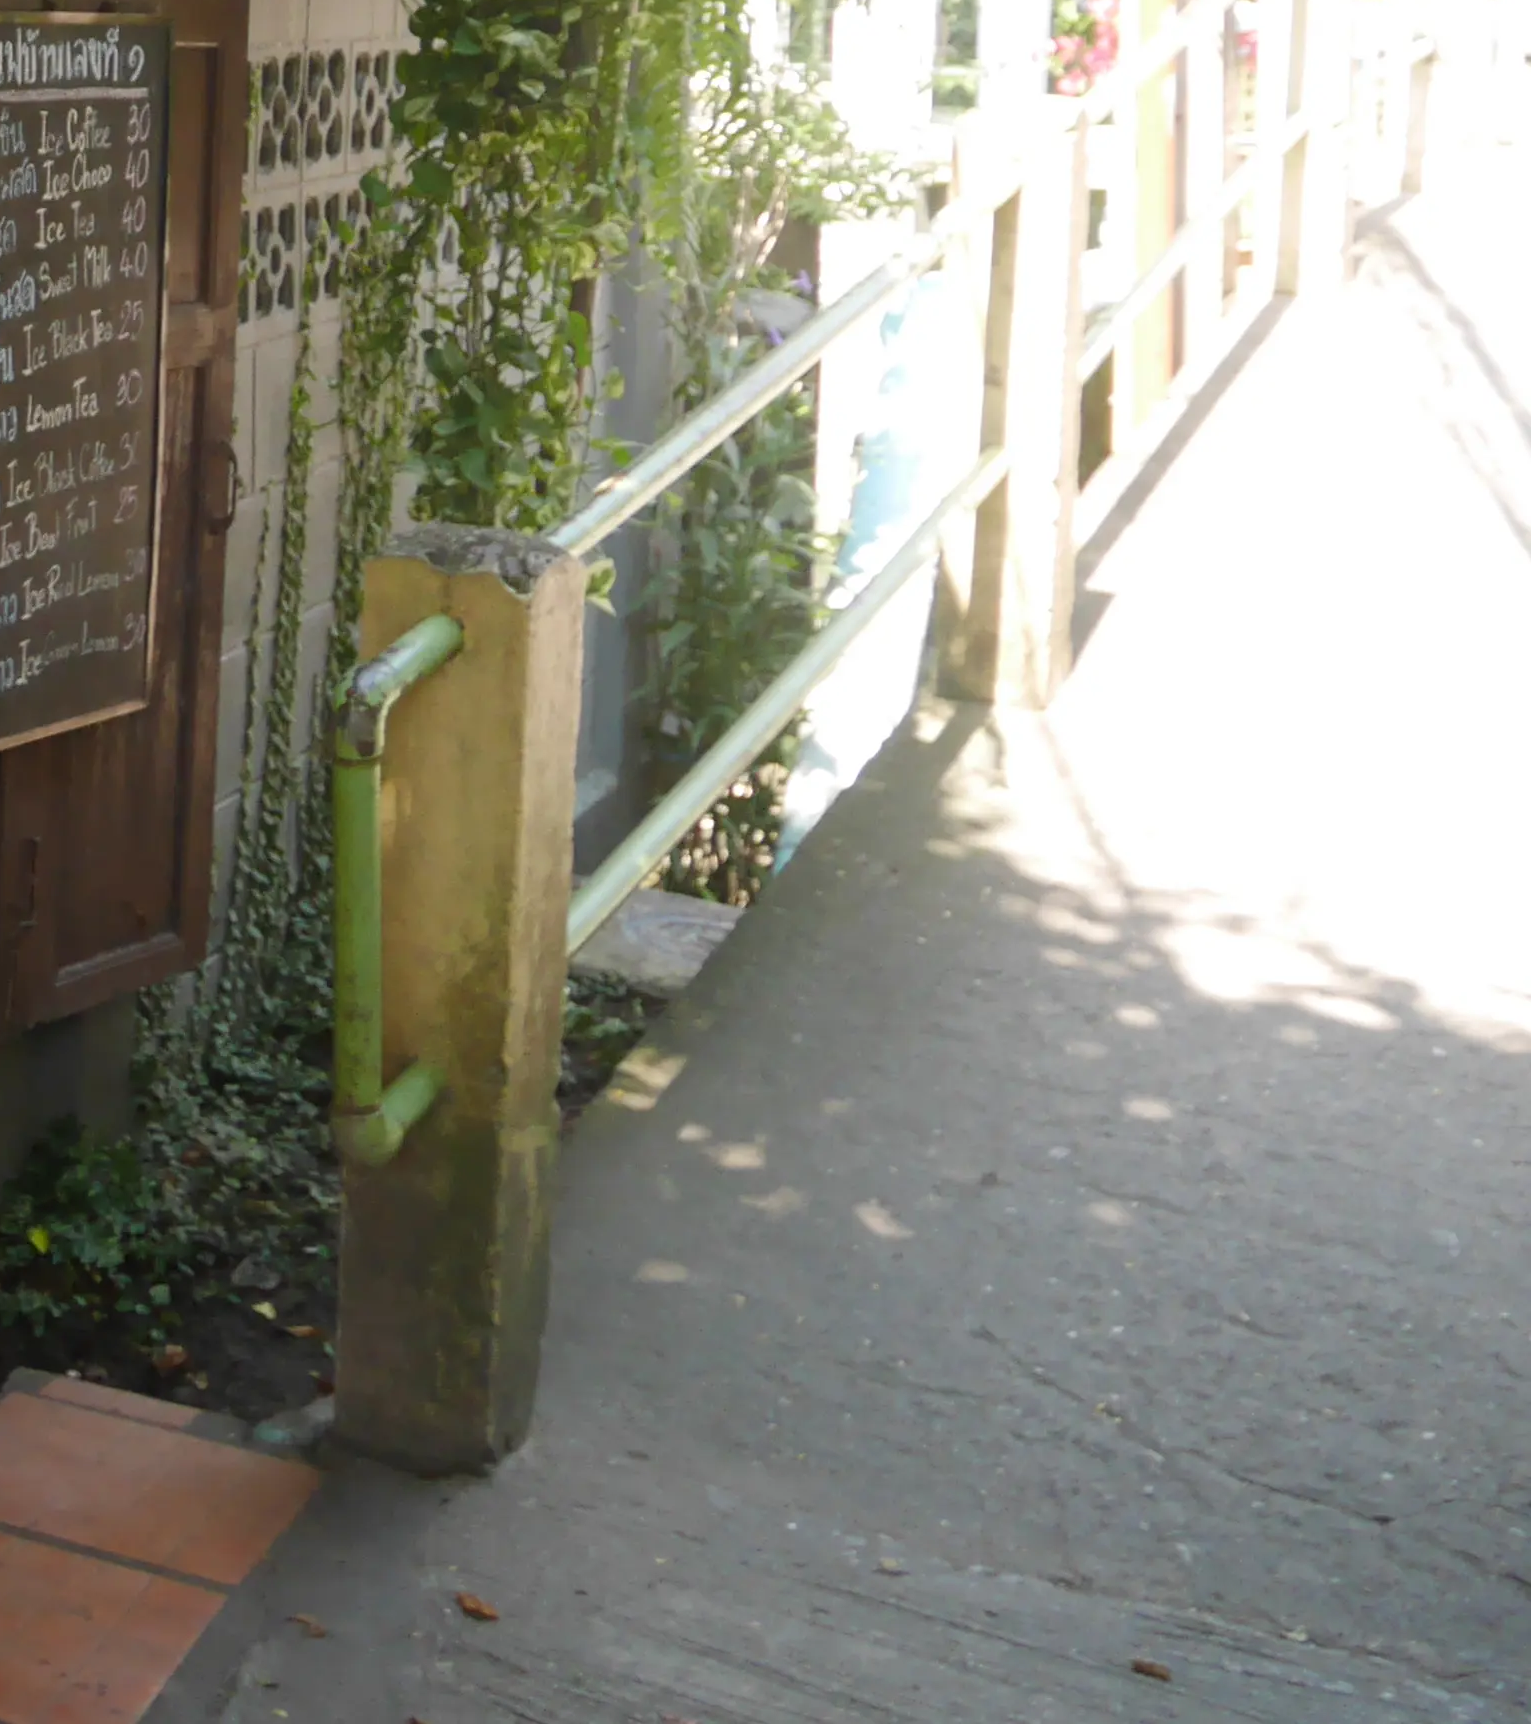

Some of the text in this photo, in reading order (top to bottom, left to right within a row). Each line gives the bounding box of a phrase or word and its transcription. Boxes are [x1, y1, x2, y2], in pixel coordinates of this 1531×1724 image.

[38, 110, 64, 156] Ice
[66, 106, 112, 152] Coffee
[127, 102, 150, 145] 30
[42, 159, 70, 201] Ice
[72, 152, 112, 192] Choco
[124, 148, 149, 189] 40
[34, 207, 66, 250] Ice
[71, 200, 95, 240] Tea
[121, 195, 147, 234] 40
[83, 244, 111, 289] Milk
[119, 241, 148, 278] 40
[21, 323, 48, 376] Ice
[48, 314, 88, 360] Black
[90, 309, 114, 347] Tea
[26, 393, 72, 432] Lemon
[73, 376, 99, 419] Tea
[115, 367, 143, 406] 30
[5, 458, 34, 508] Ice
[113, 485, 138, 524] 25
[20, 577, 46, 620] Ice
[15, 638, 42, 685] Ice
